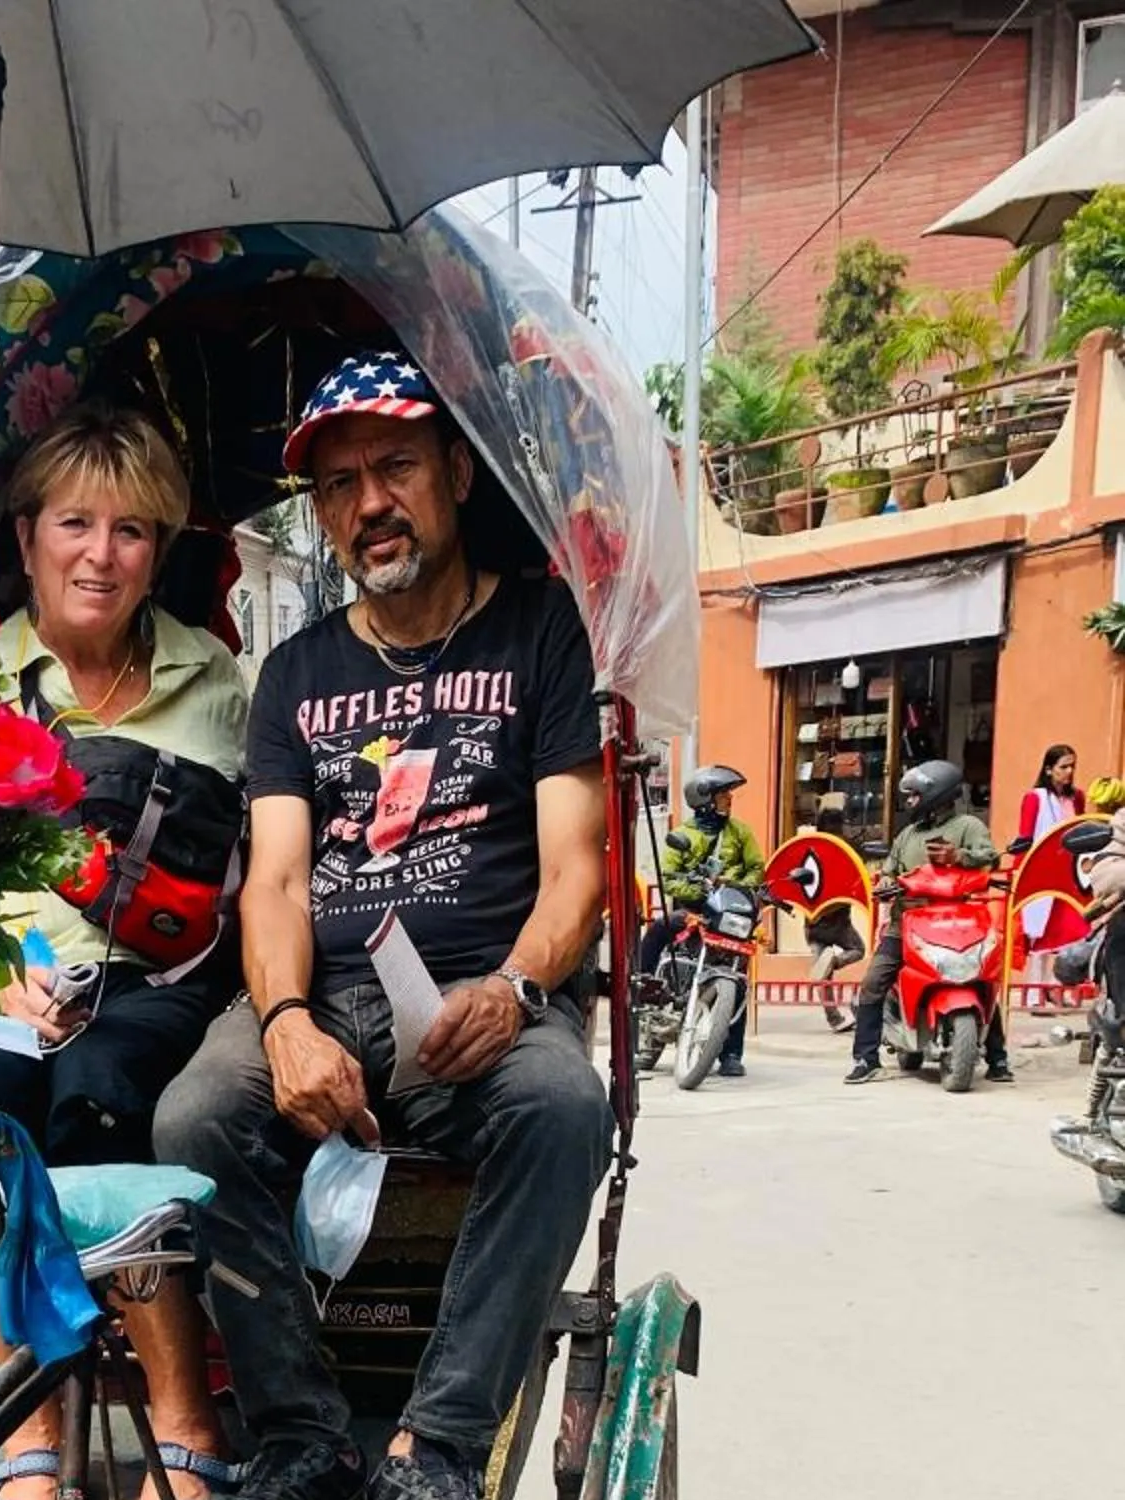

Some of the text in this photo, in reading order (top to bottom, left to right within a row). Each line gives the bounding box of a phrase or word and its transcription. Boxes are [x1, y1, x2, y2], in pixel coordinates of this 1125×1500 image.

[296, 670, 518, 745] RAFFLES HOTEL
[381, 720, 406, 732] EST
[460, 743, 494, 765] BAR
[315, 760, 352, 784] ONG
[402, 853, 462, 883] SLING
